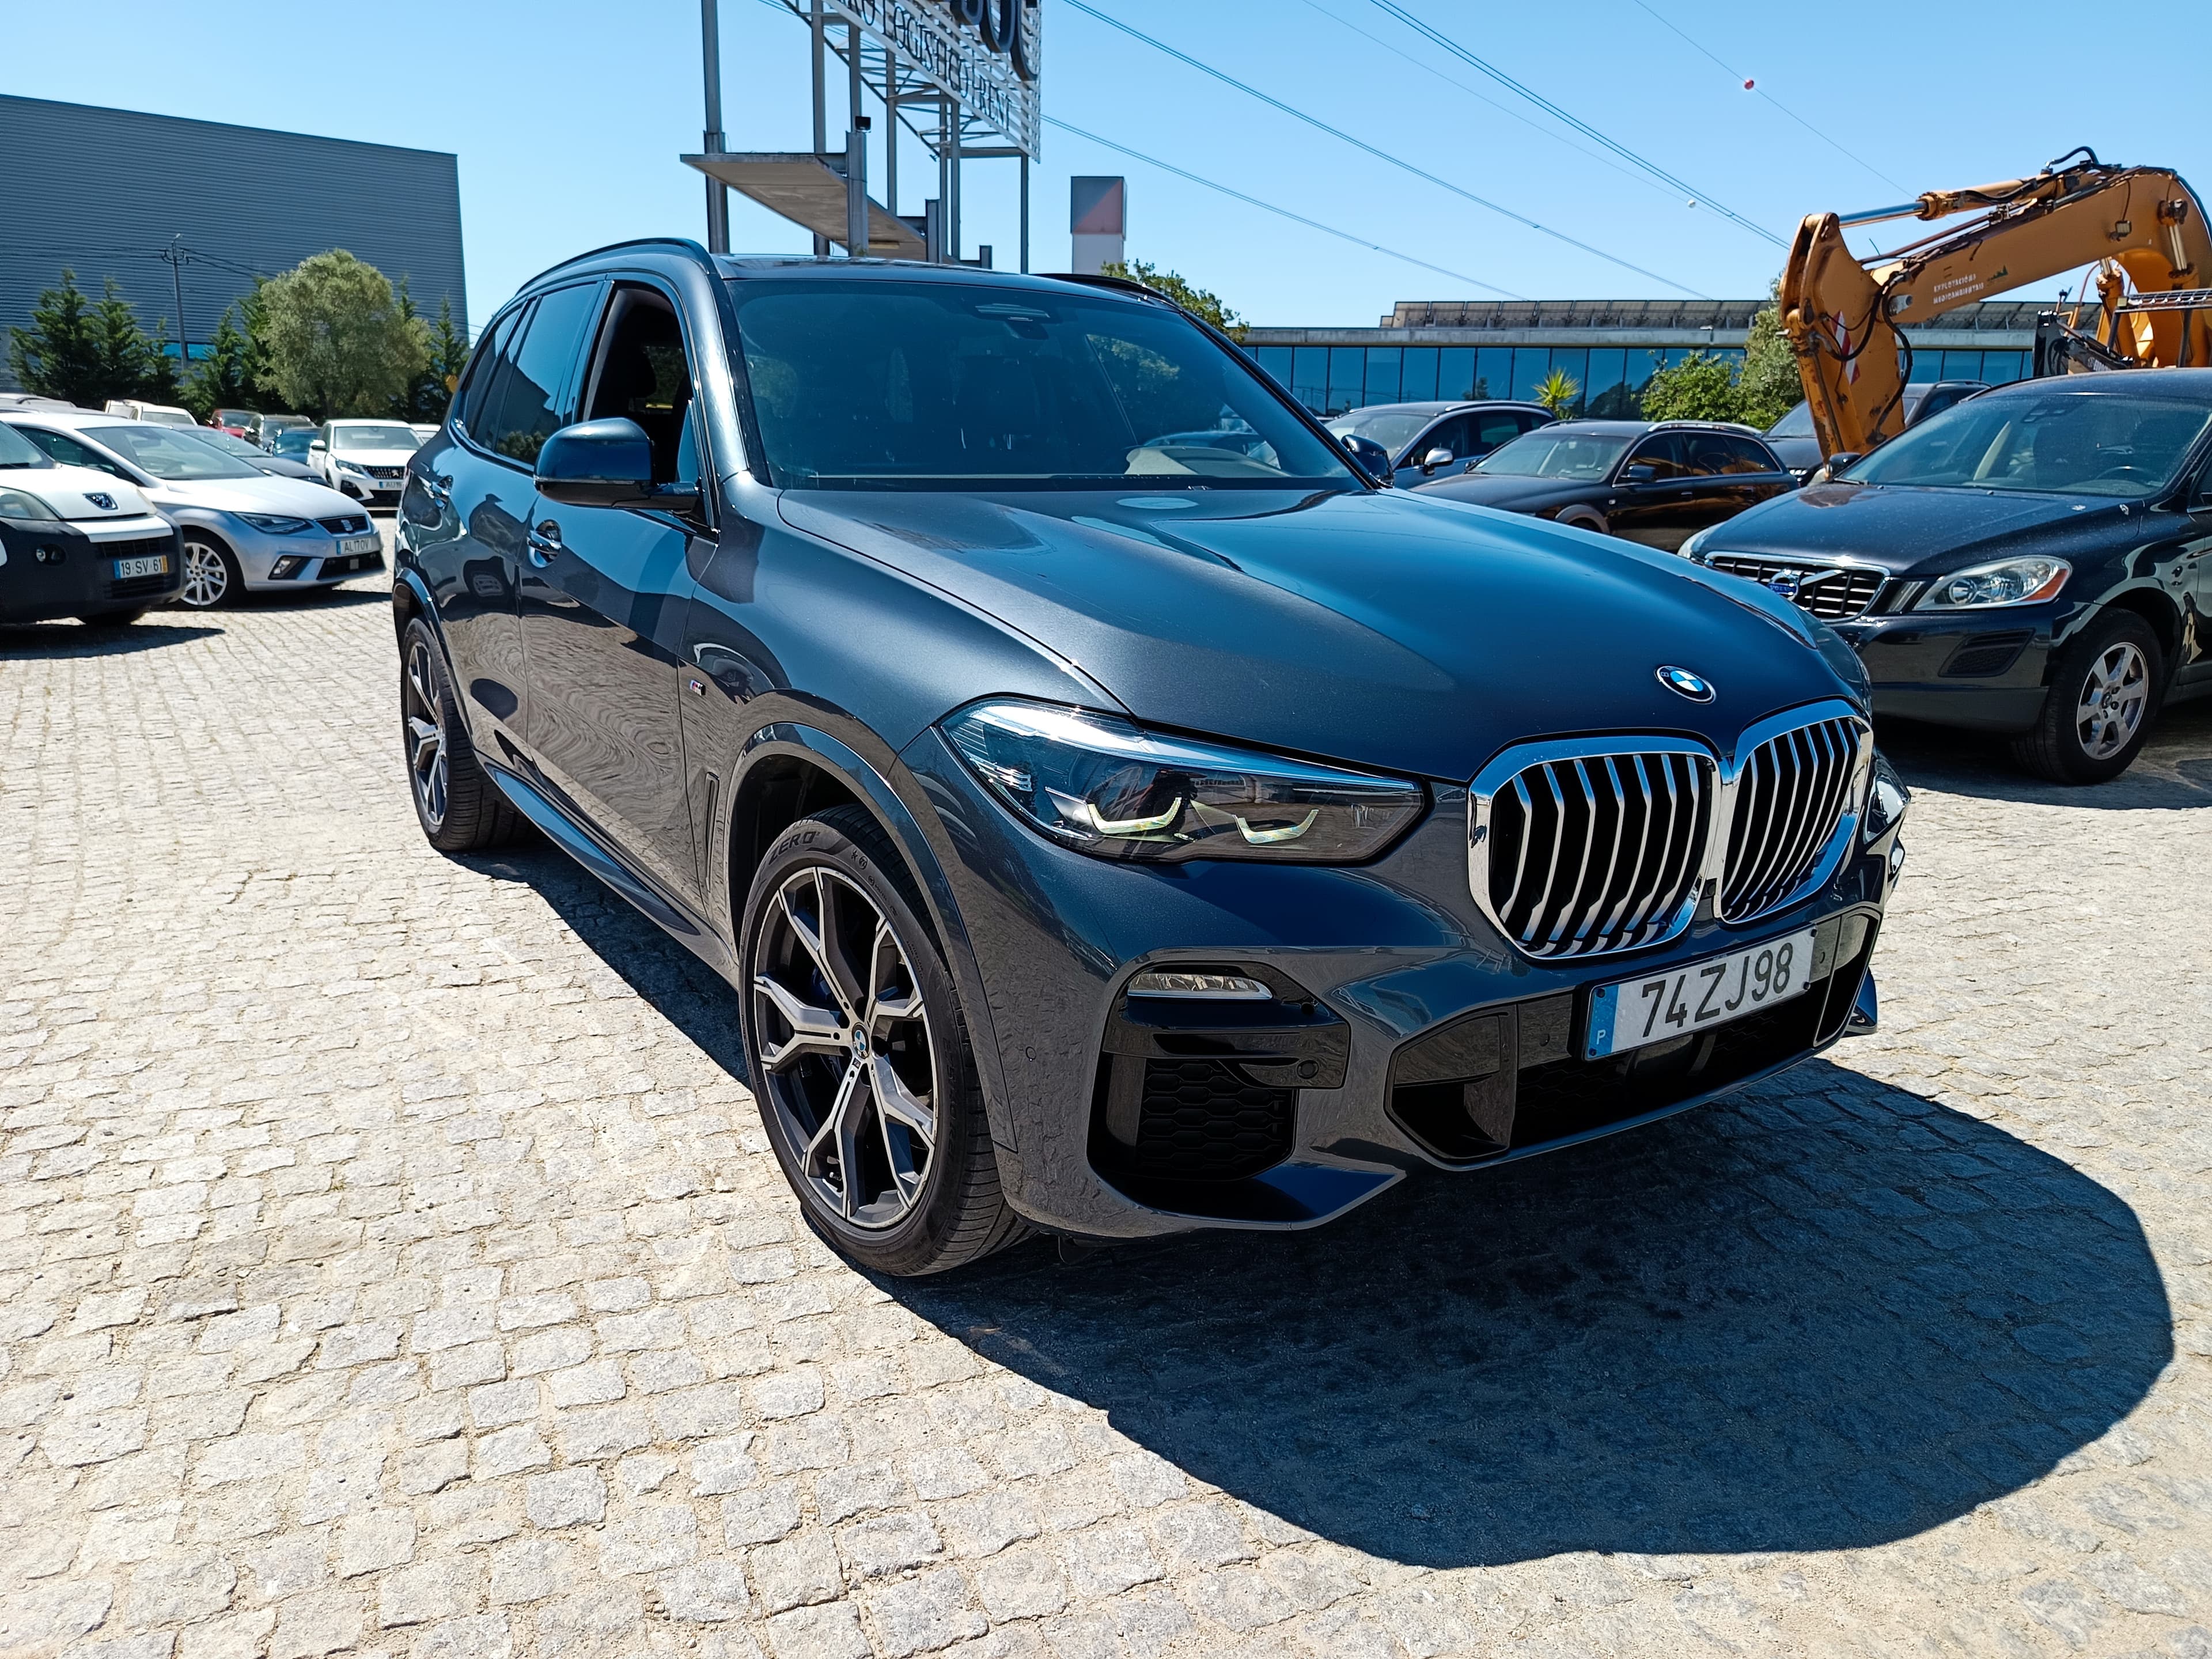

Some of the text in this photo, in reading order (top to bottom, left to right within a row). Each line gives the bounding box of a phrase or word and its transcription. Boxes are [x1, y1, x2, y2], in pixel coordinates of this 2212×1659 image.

[768, 831, 817, 865] ZERO
[1641, 942, 1793, 1038] 74ZJ98
[1596, 1029, 1607, 1045] P
